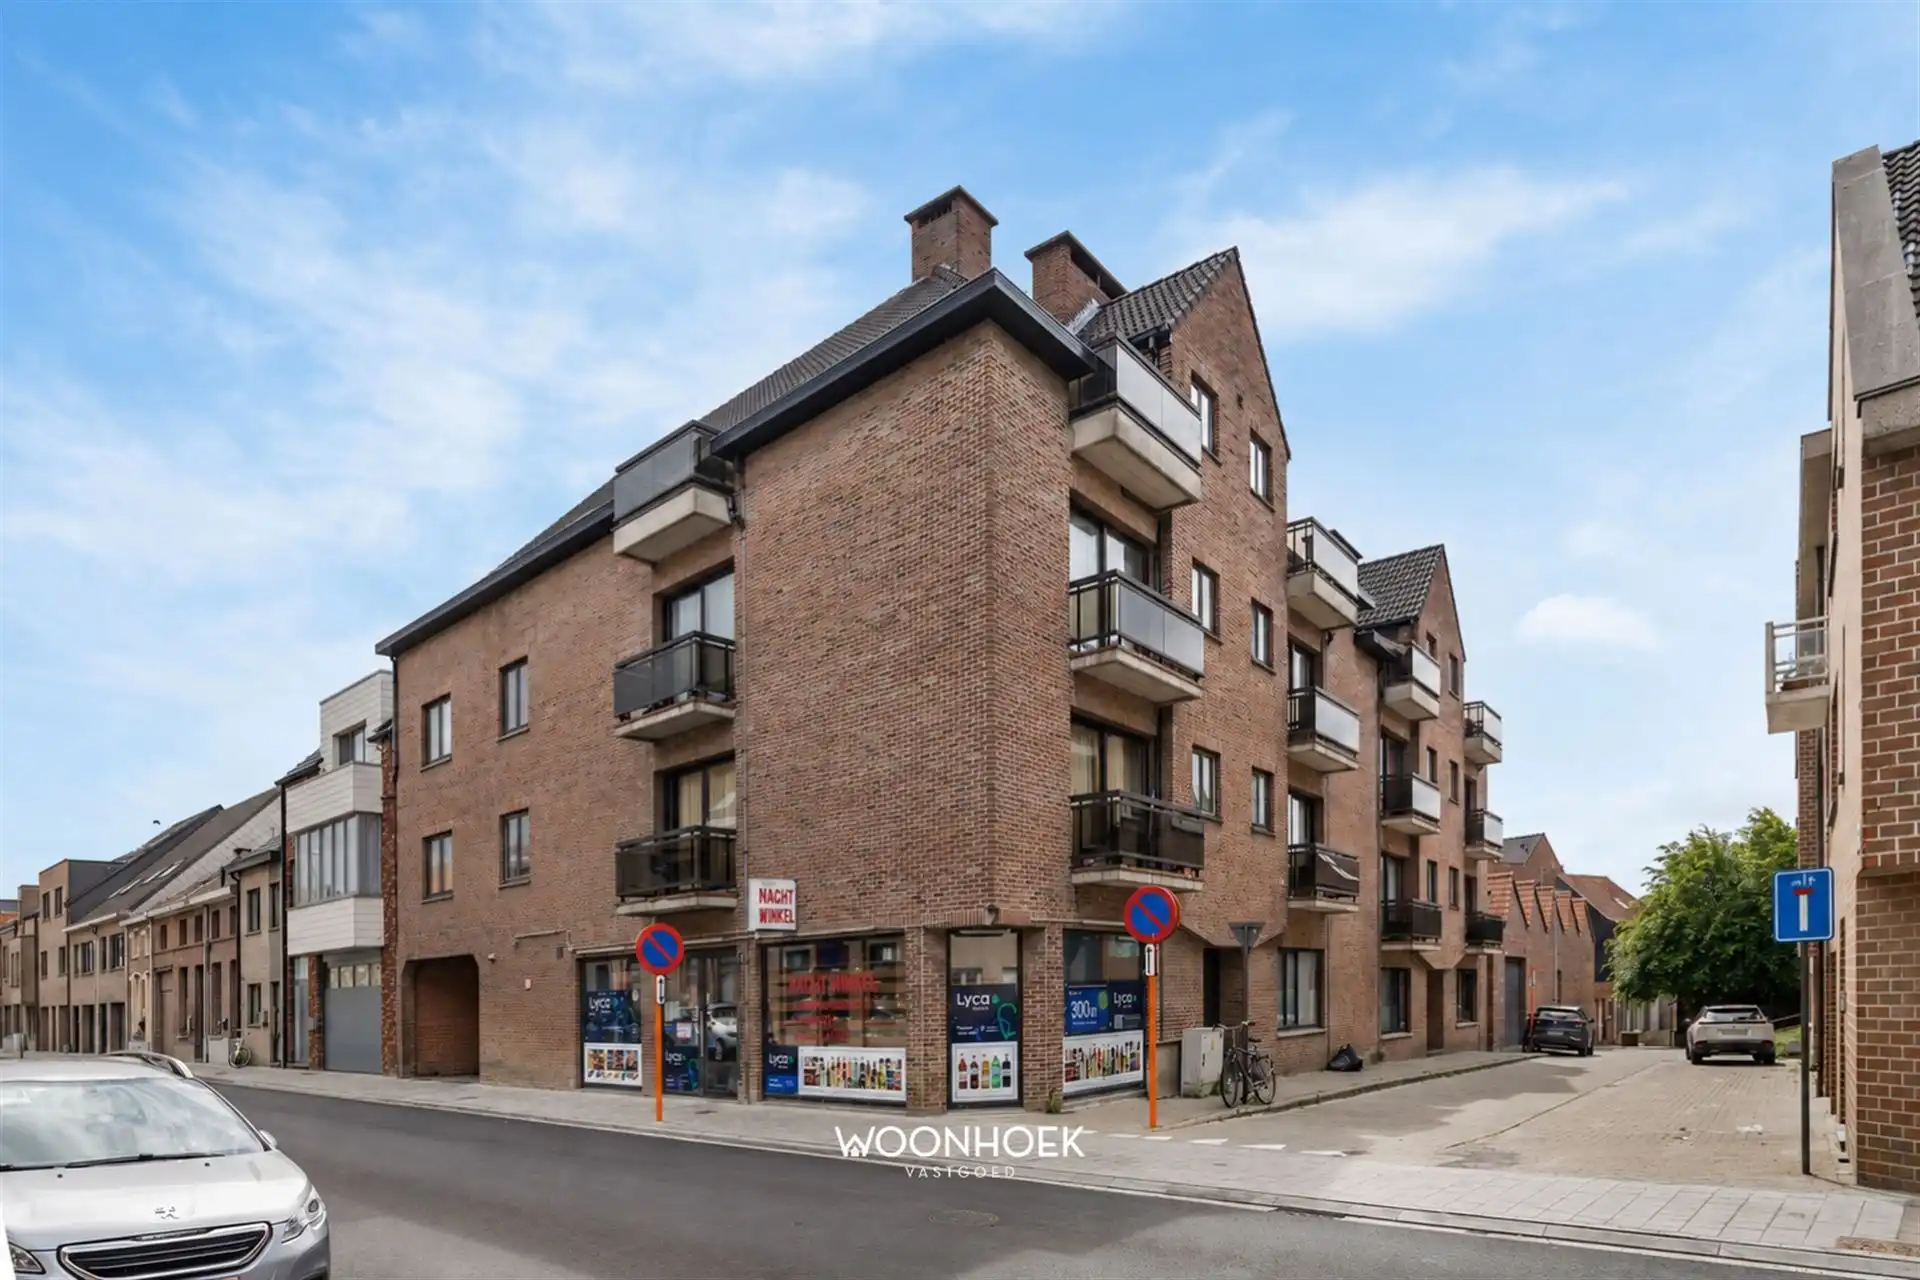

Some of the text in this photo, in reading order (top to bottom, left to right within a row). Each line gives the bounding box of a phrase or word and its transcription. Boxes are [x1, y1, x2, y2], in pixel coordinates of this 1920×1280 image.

[759, 887, 794, 904] NACHT
[759, 908, 796, 924] WINKEL
[956, 993, 990, 1008] Lyca
[1113, 992, 1133, 1007] Lyca
